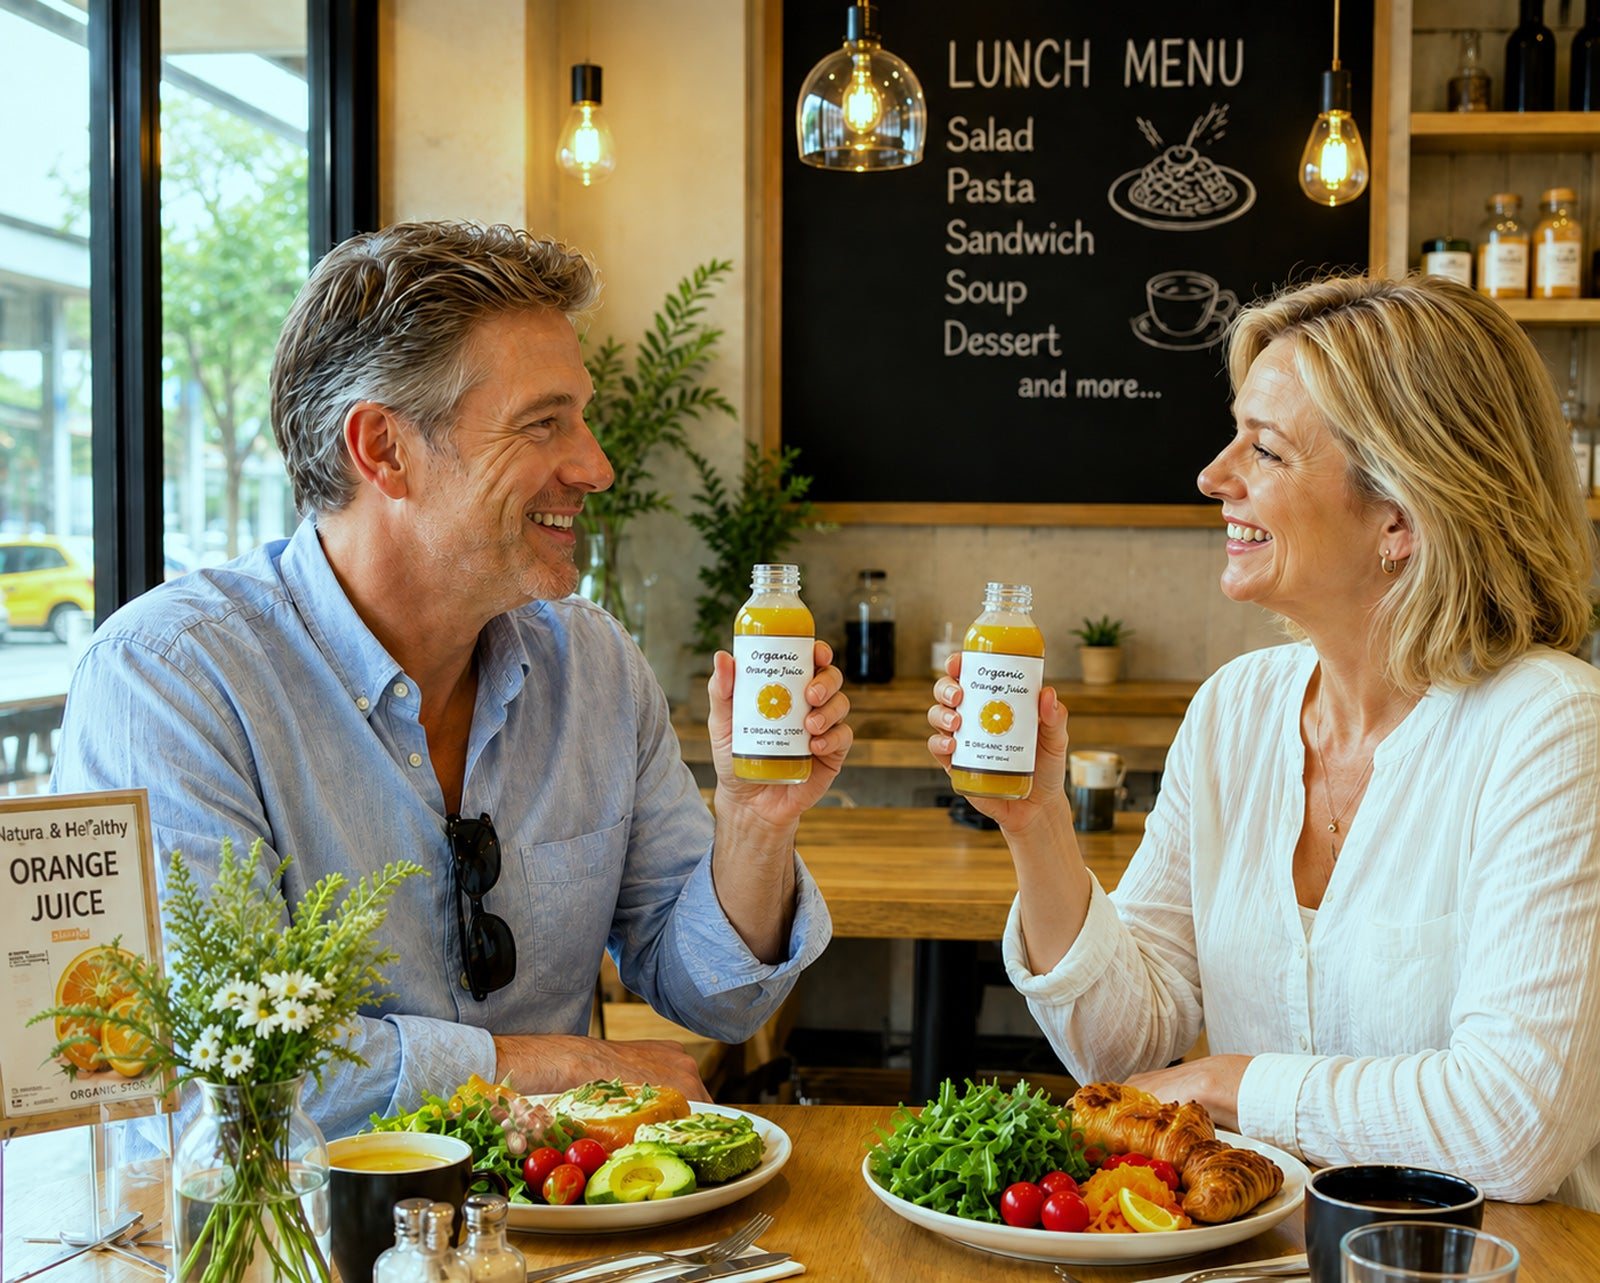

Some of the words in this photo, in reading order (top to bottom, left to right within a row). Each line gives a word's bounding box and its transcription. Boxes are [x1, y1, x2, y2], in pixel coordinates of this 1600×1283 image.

[948, 38, 1091, 88] LUNCH
[1123, 38, 1244, 88] MENU
[946, 115, 1034, 152] Salad
[947, 167, 1036, 204] Pasta
[945, 218, 1095, 255] Sandwich
[944, 268, 1028, 317] Soup
[943, 319, 1062, 357] Dessert
[1017, 369, 1067, 398] and
[1075, 376, 1162, 399] more...
[745, 666, 779, 678] Orange
[779, 666, 804, 678] Juice
[751, 650, 799, 664] Organic
[977, 666, 1025, 681] Organic
[970, 681, 1004, 695] Orange
[1004, 684, 1029, 695] Juice
[50, 822, 61, 839] &
[9, 850, 119, 885] ORANGE
[30, 889, 105, 922] JUICE
[70, 1084, 117, 1101] ORGANIC
